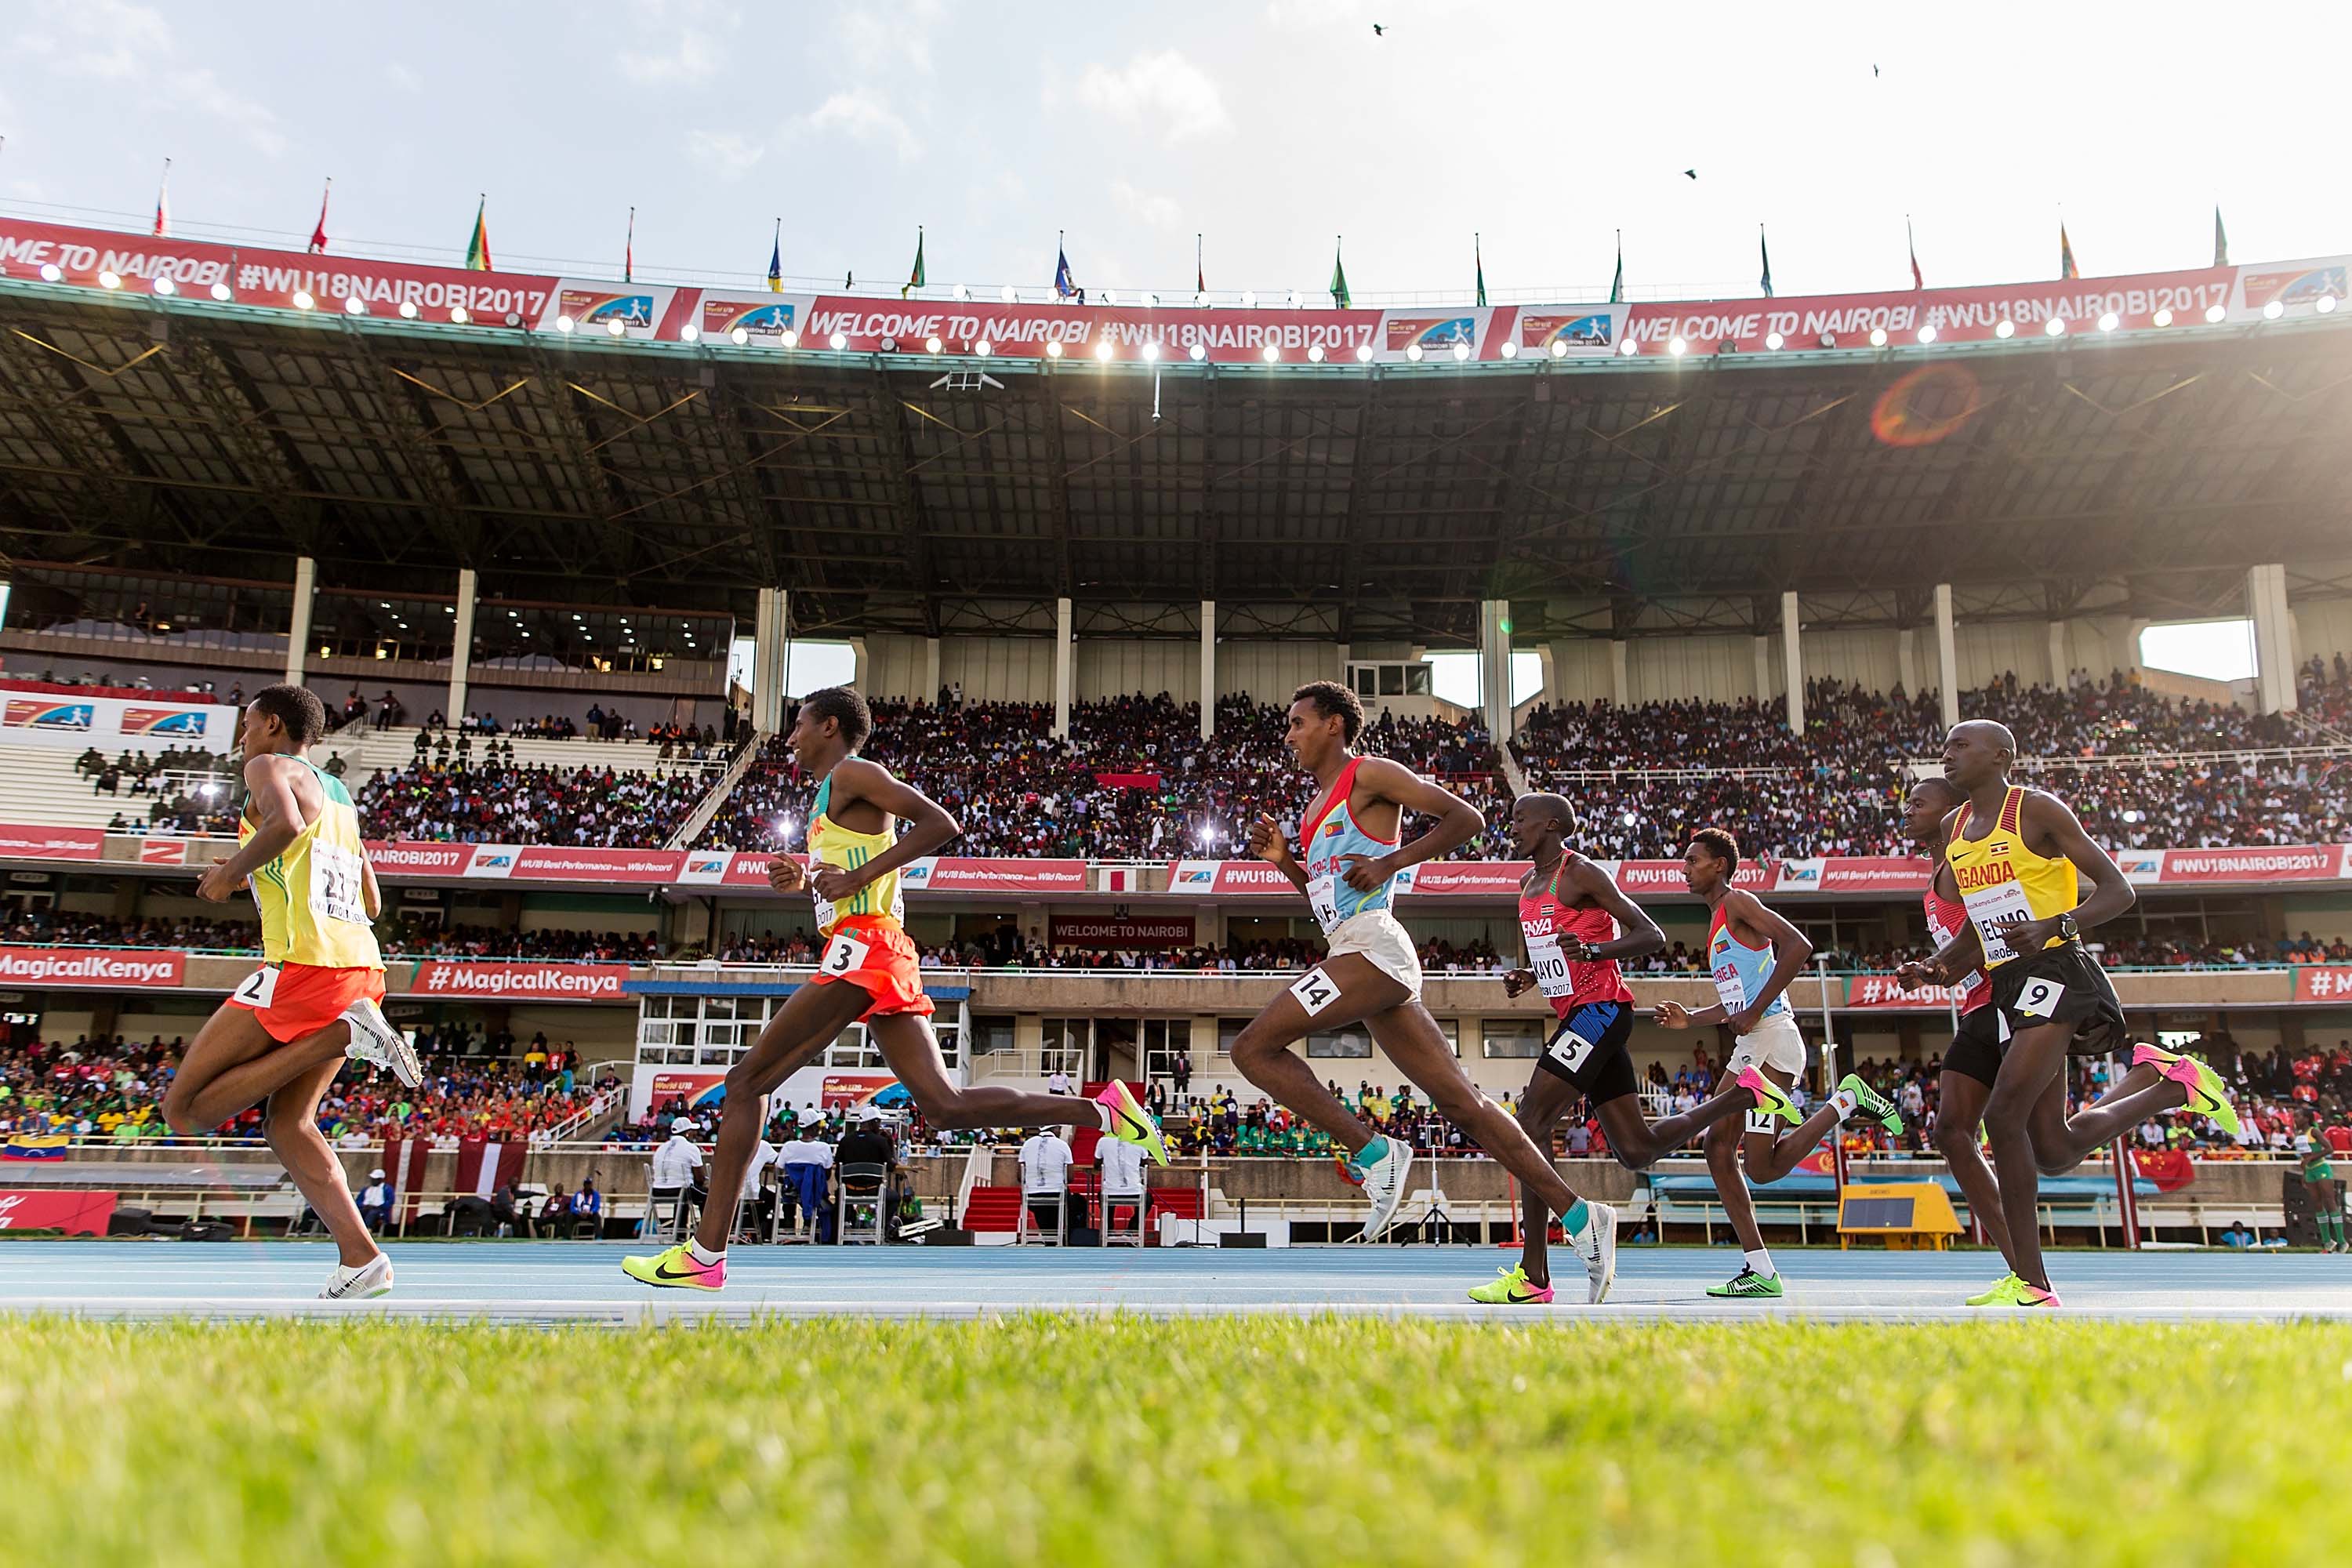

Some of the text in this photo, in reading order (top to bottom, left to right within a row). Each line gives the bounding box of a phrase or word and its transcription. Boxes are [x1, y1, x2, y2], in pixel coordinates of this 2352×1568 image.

[0, 237, 230, 286] ME TO NAIROBI
[238, 264, 546, 316] #WU18NAIROBI2017
[1927, 283, 2229, 330] #WU18NAIROBI2017
[811, 312, 1092, 344] WELCOME TO NAIROBI
[1101, 321, 1374, 349] #WU18NAIROBI2017
[1628, 305, 1916, 343] WELCOME TO NAIROBI
[521, 859, 543, 869] WU18
[543, 860, 561, 869] Best
[561, 861, 613, 871] Performance
[644, 862, 673, 872] Record
[2172, 854, 2328, 873] #WU18NAIROBI2017
[976, 871, 1024, 880] Performance
[1054, 873, 1082, 881] Record
[1420, 876, 1441, 884] WU18
[1442, 876, 1458, 884] Best
[1459, 876, 1507, 884] Performance
[1827, 871, 1849, 880] WU18
[1849, 870, 1867, 880] Best
[1867, 870, 1918, 880] Performance
[818, 908, 834, 926] 2017
[1056, 925, 1189, 938] WELCOME TO NAIROBI
[832, 944, 853, 971] 3
[1987, 946, 2017, 961] NAIROB
[244, 971, 265, 1000] 2
[429, 966, 618, 993] #MagicalKenya
[1552, 984, 1570, 996] 2017
[1299, 975, 1331, 1007] 14
[2028, 985, 2049, 1006] 9
[1560, 1038, 1582, 1061] 5
[1750, 1110, 1770, 1129] 12
